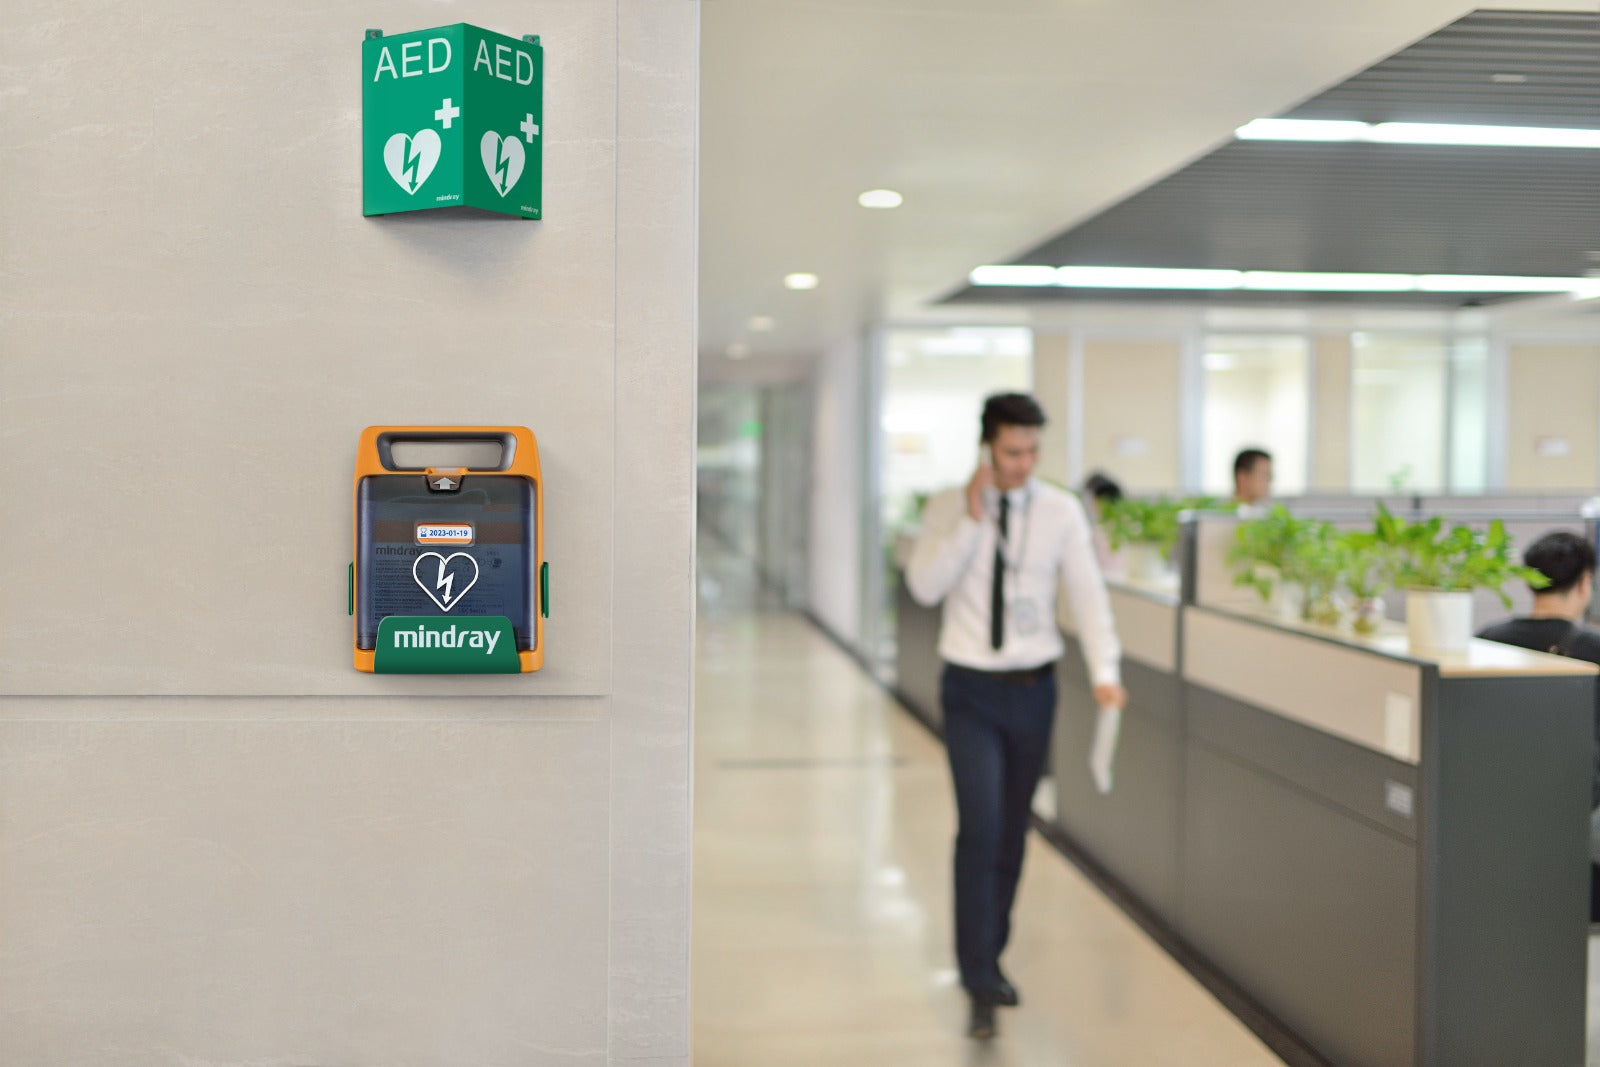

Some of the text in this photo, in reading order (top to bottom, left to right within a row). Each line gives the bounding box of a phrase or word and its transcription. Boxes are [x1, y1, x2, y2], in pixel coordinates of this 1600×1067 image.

[373, 37, 452, 82] AED
[473, 38, 534, 86] AED
[429, 529, 468, 537] 2023-01-19
[394, 624, 501, 654] mindray
